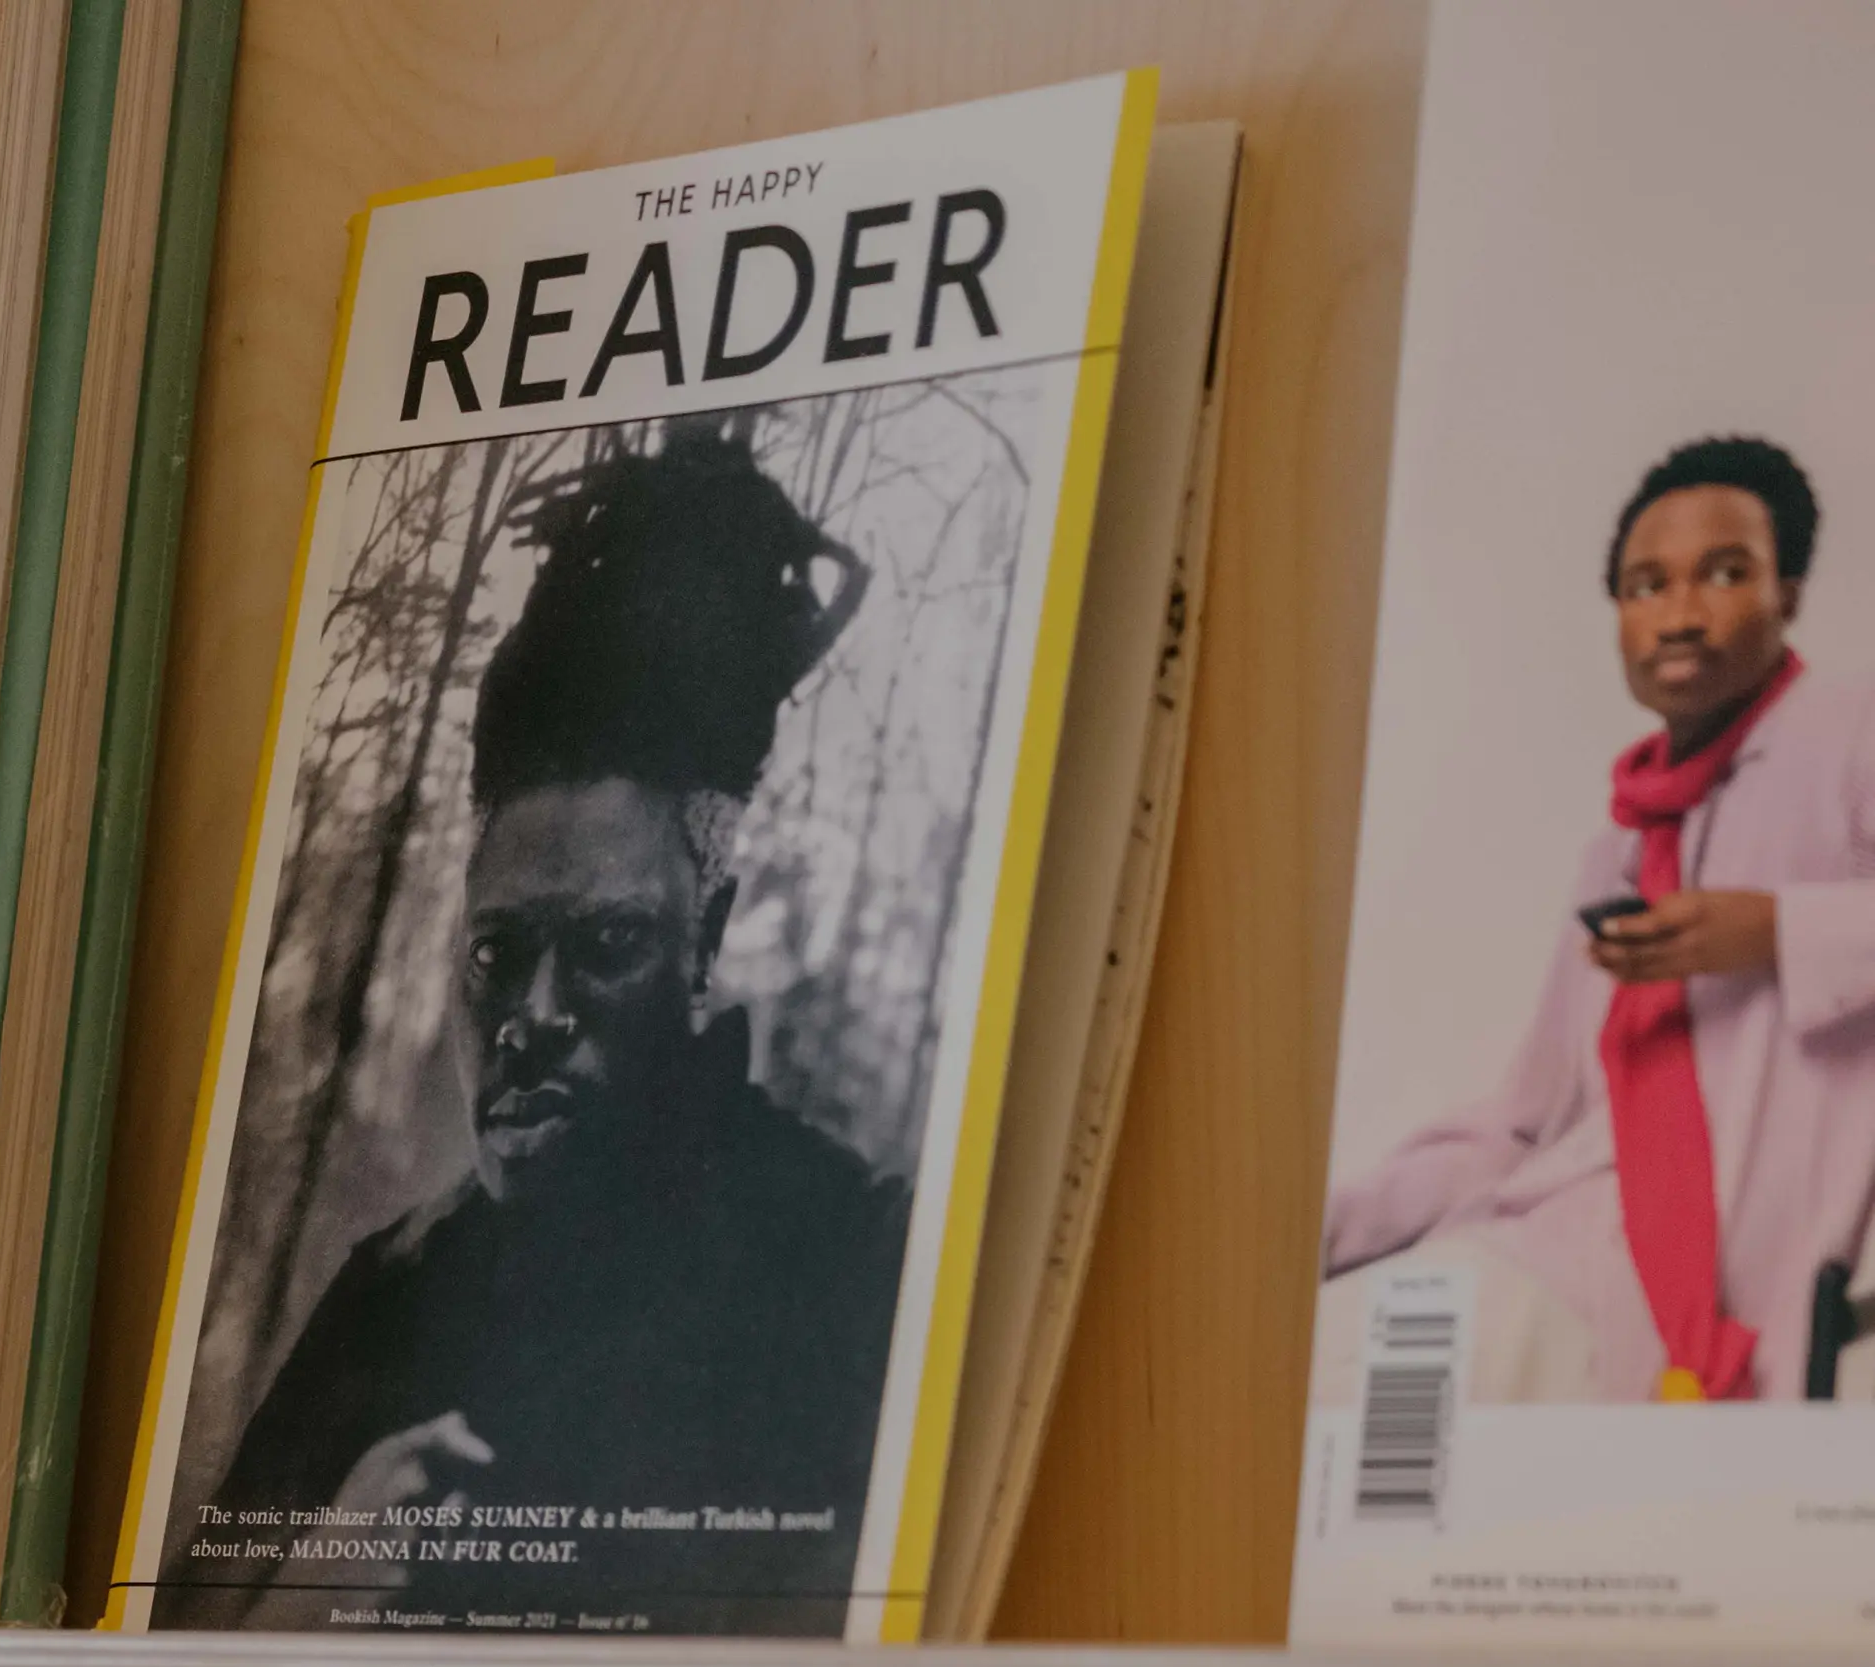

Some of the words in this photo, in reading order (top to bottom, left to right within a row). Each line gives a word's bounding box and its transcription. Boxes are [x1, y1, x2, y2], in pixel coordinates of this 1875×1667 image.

[634, 183, 698, 221] THE
[711, 161, 826, 211] HAPPY
[400, 188, 1007, 422] READER
[198, 1505, 232, 1525] The
[237, 1505, 282, 1525] sonic
[289, 1506, 378, 1526] trailblazer
[382, 1506, 463, 1528] MOSES
[470, 1506, 575, 1529] SUMNEY
[579, 1507, 600, 1529] &
[602, 1511, 616, 1529] a
[621, 1506, 698, 1530] brilliant
[702, 1506, 775, 1531] Turkish
[779, 1507, 836, 1531] novel
[191, 1540, 241, 1559] about
[244, 1540, 285, 1561] love,
[289, 1539, 411, 1560] MADONNA
[418, 1540, 446, 1561] IN
[452, 1540, 502, 1562] FUR
[509, 1540, 579, 1563] COAT.
[329, 1608, 381, 1625] Bookish
[384, 1609, 446, 1628] Magazine
[466, 1611, 521, 1628] Summer
